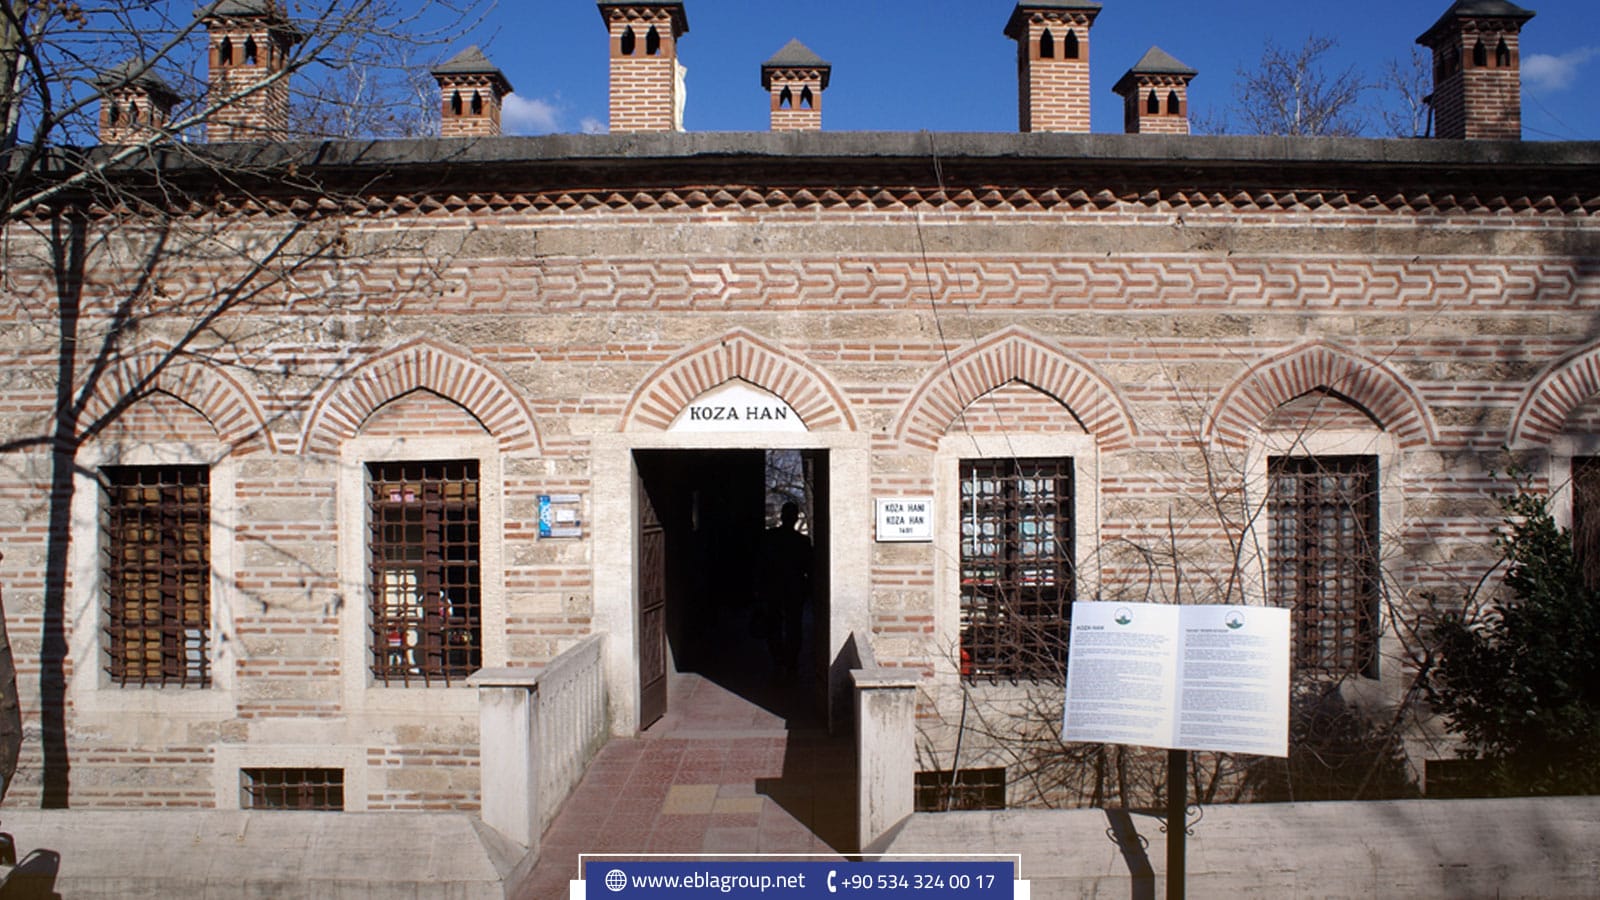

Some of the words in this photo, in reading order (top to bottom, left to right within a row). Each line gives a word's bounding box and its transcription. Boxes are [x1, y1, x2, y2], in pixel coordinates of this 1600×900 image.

[690, 406, 740, 421] KOZA
[746, 406, 788, 421] HAN
[885, 503, 905, 513] KOZA
[907, 503, 925, 512] HANI
[886, 515, 905, 525] KOZA
[908, 515, 925, 525] HAN
